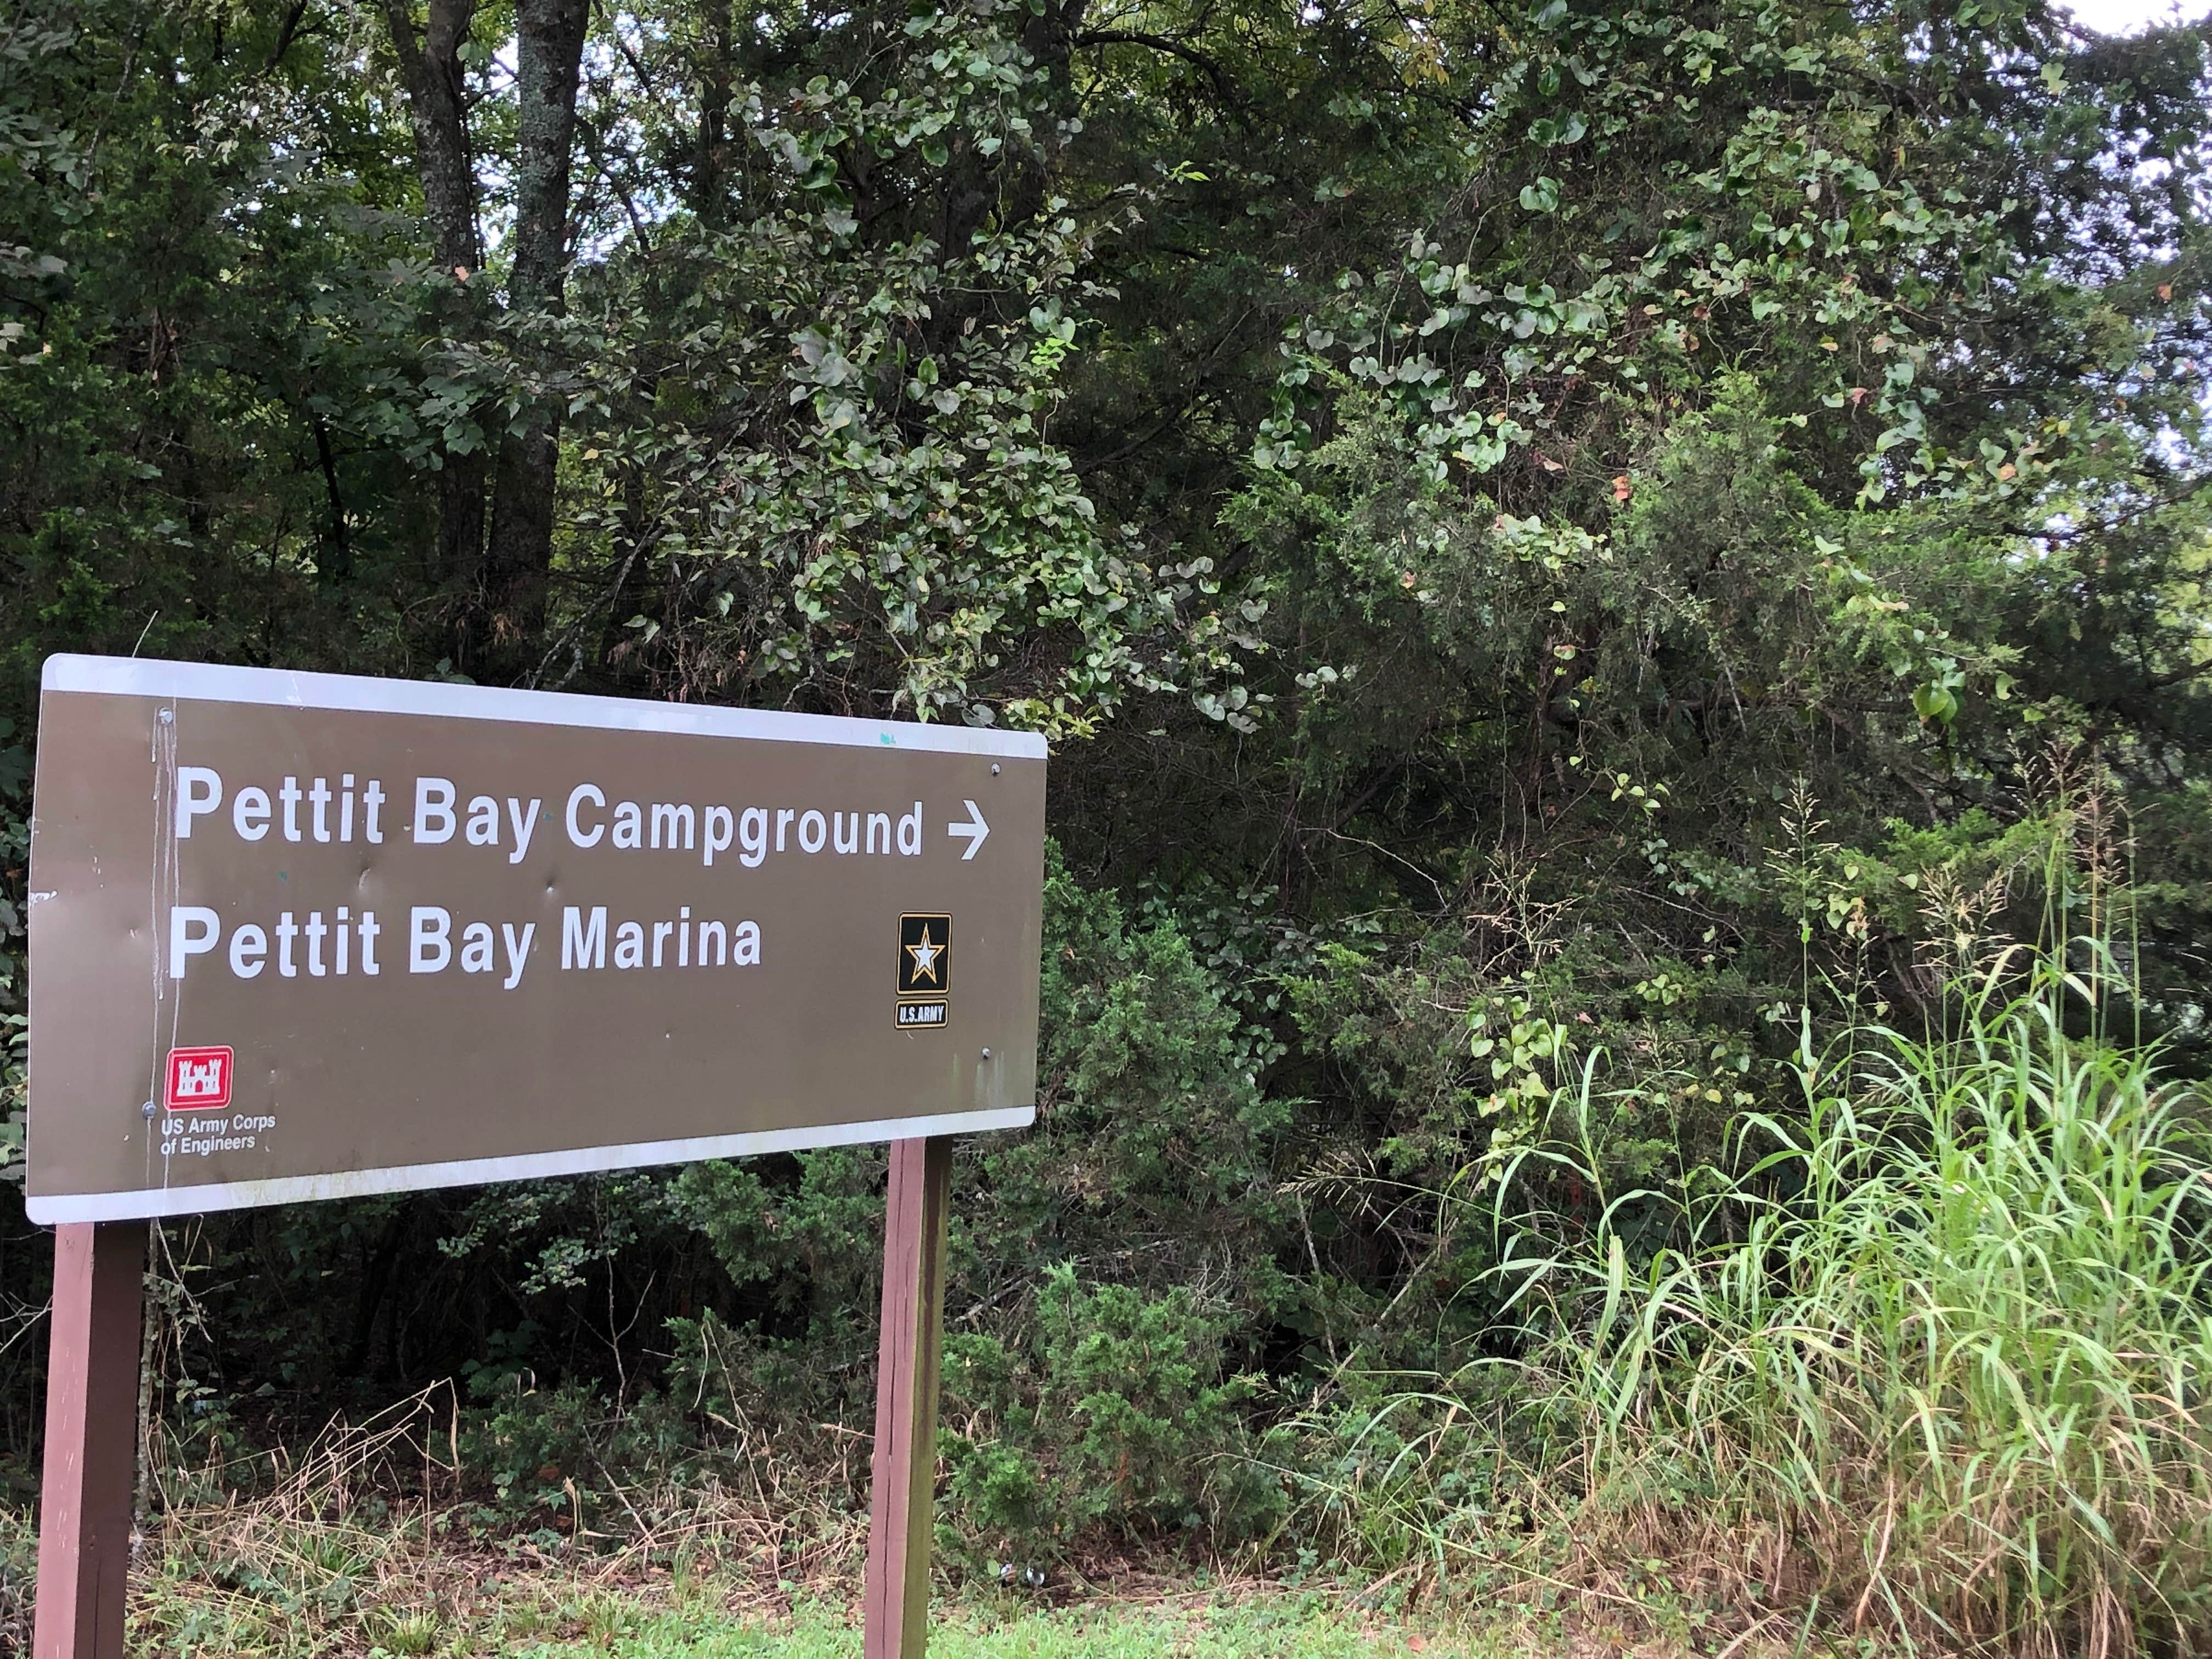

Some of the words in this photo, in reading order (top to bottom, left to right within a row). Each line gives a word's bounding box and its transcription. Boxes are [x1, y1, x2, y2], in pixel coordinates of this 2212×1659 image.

[174, 766, 386, 844] Pettit
[413, 777, 541, 864] Bay
[566, 783, 923, 868] Campground
[169, 906, 380, 979] Pettit
[409, 906, 536, 990] Bay
[561, 906, 761, 970] Marina
[160, 1138, 177, 1155] of
[180, 1135, 256, 1156] Engineers
[161, 1118, 184, 1136] US
[188, 1117, 228, 1135] Army
[233, 1114, 276, 1132] Corps
